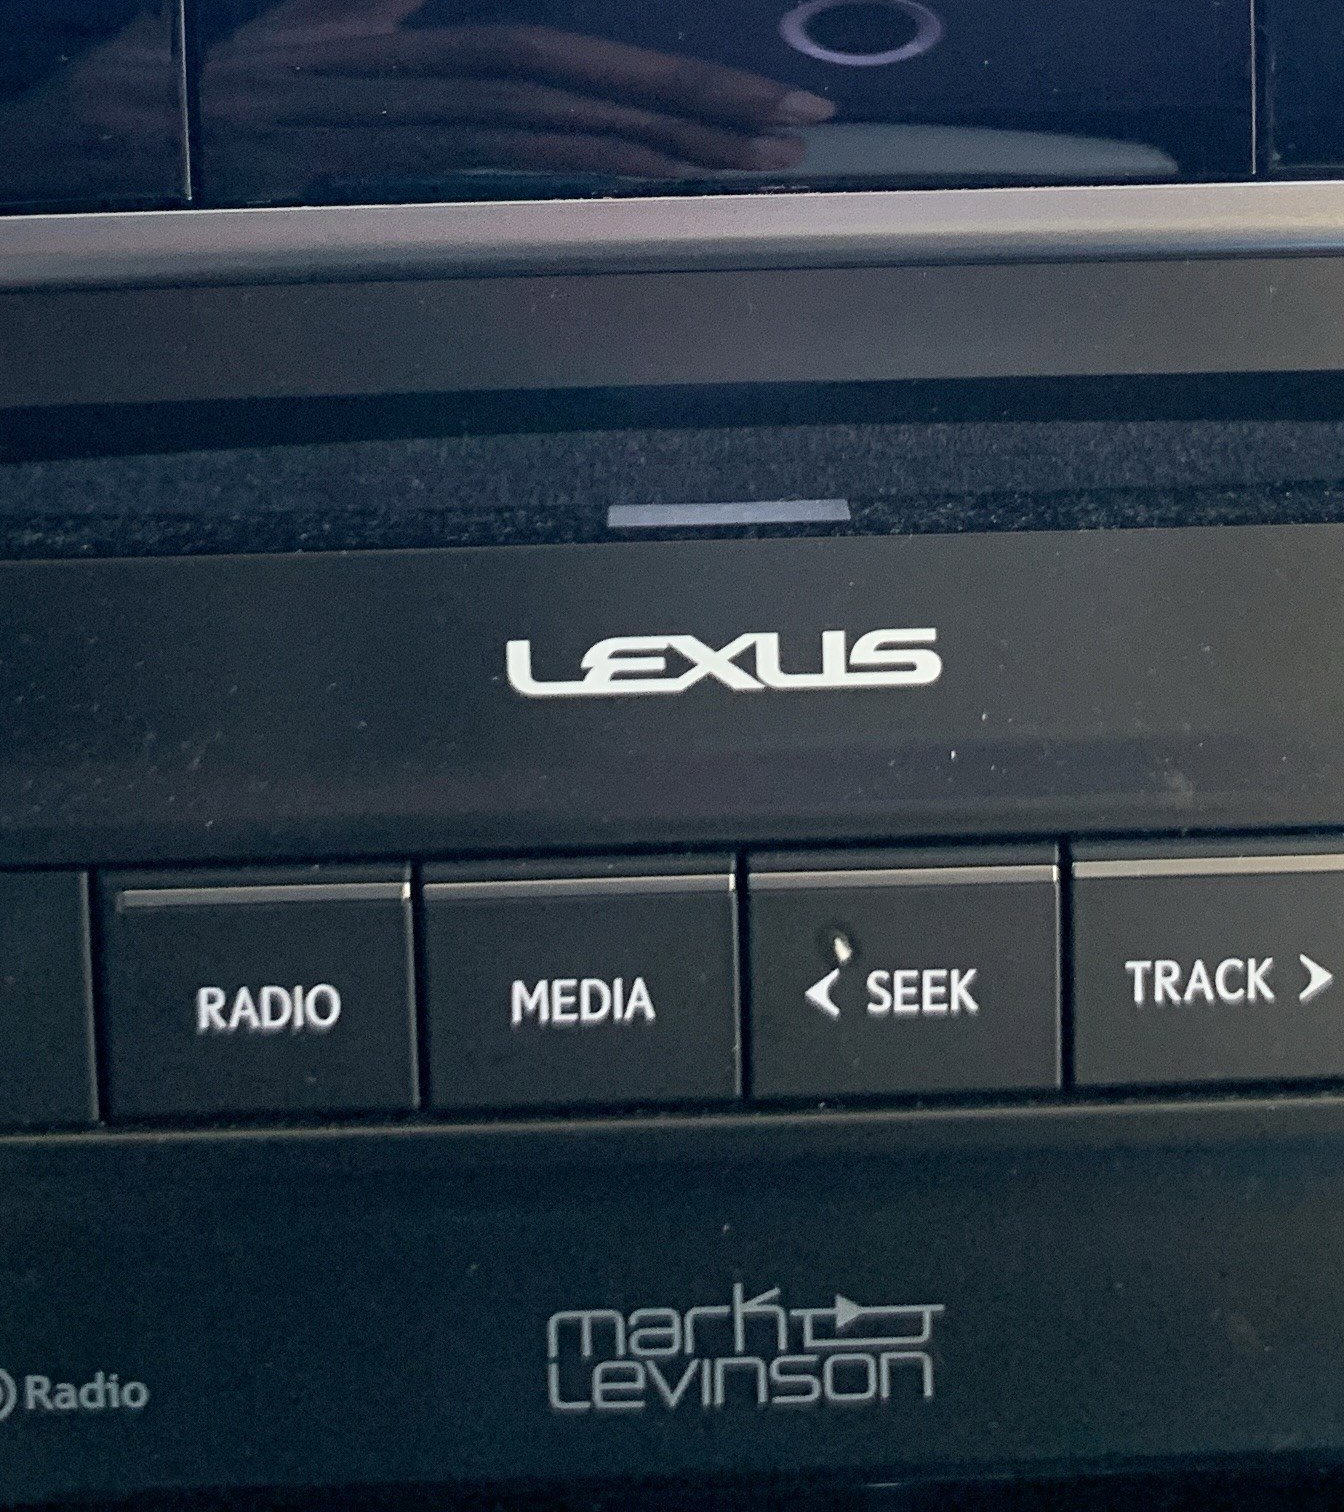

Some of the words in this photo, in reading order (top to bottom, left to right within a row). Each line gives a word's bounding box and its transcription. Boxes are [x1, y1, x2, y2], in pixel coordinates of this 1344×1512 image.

[506, 627, 943, 696] LEXUS
[512, 977, 656, 1024] MEDIA
[866, 968, 979, 1014] SEEK
[1125, 957, 1275, 1004] TRACK
[198, 983, 341, 1030] RADIO
[25, 1371, 149, 1410] Radio
